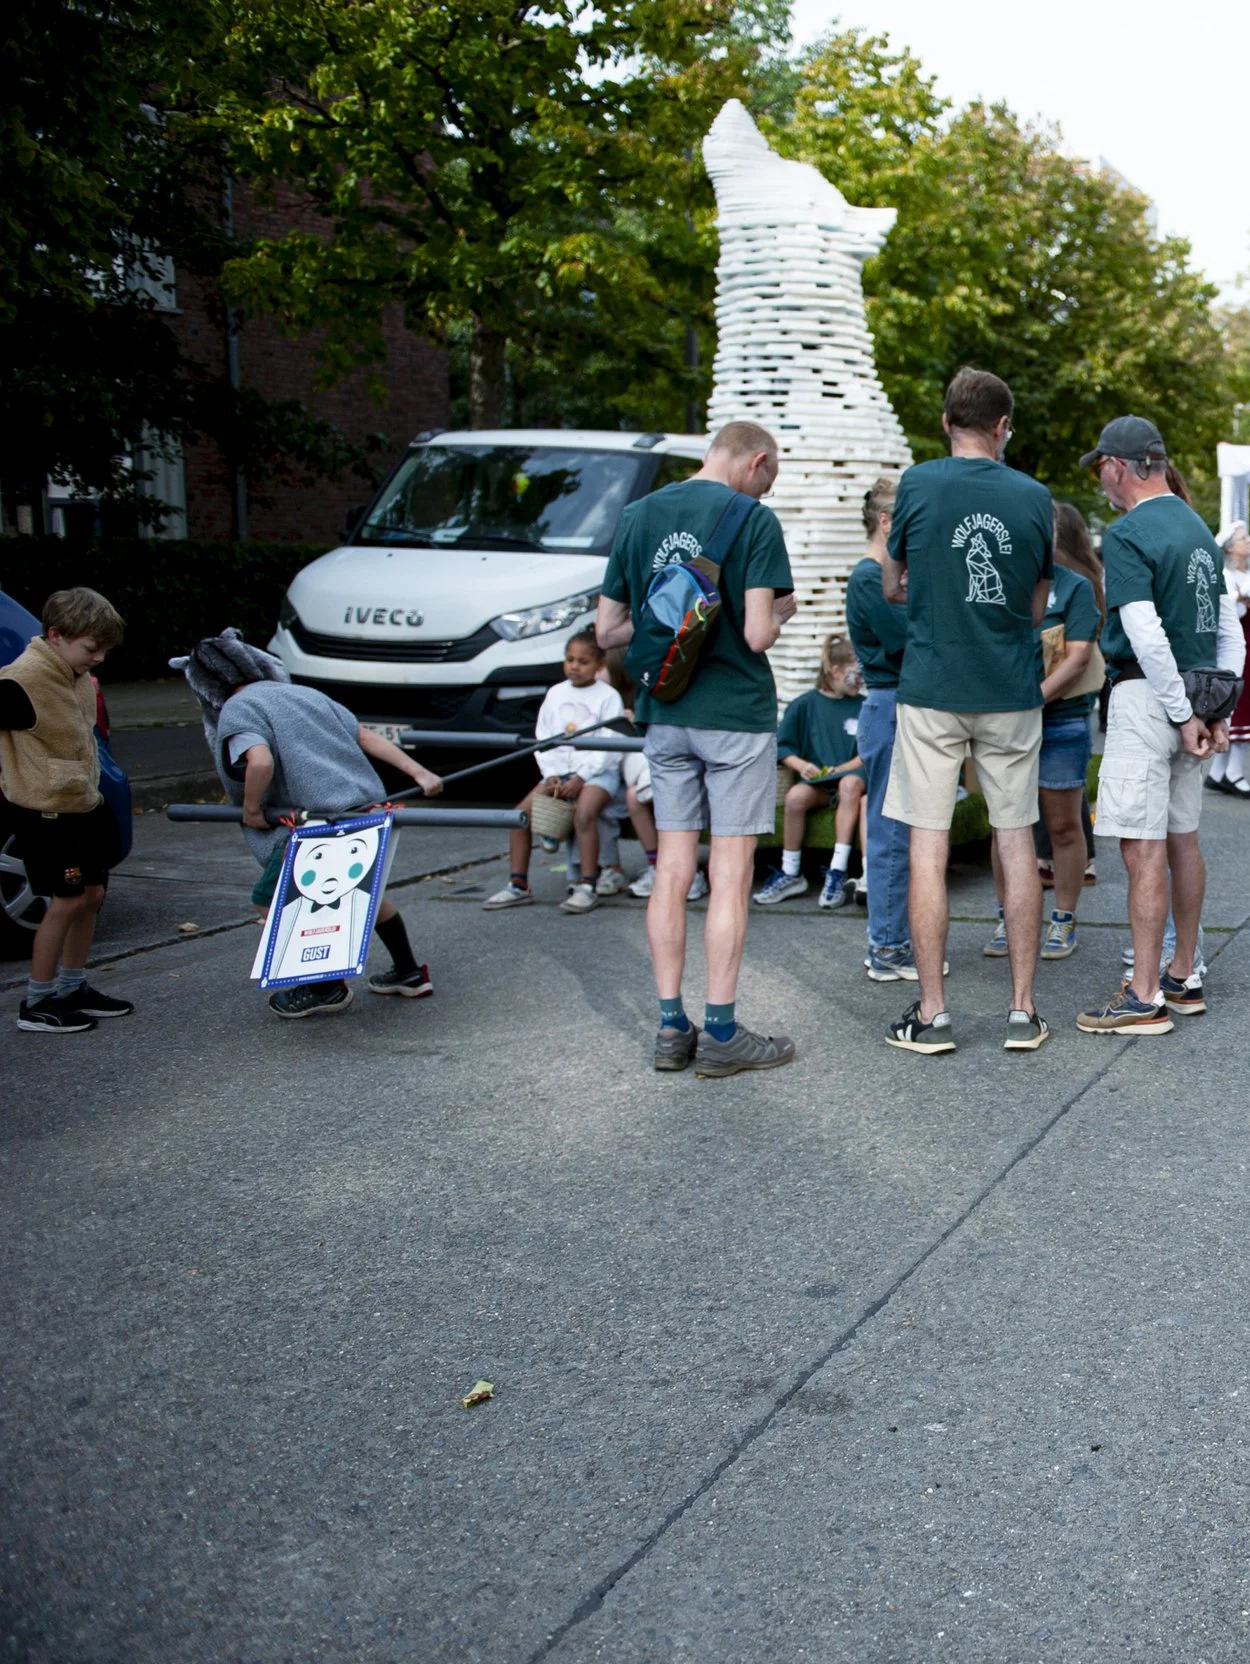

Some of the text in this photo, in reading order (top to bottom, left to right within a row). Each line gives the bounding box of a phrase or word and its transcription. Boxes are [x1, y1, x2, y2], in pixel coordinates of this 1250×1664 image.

[951, 513, 1012, 554] WOLFJAGERSLEI
[652, 531, 703, 573] WOLFJAGERS
[344, 606, 425, 627] IVECO
[302, 946, 329, 961] GUST
